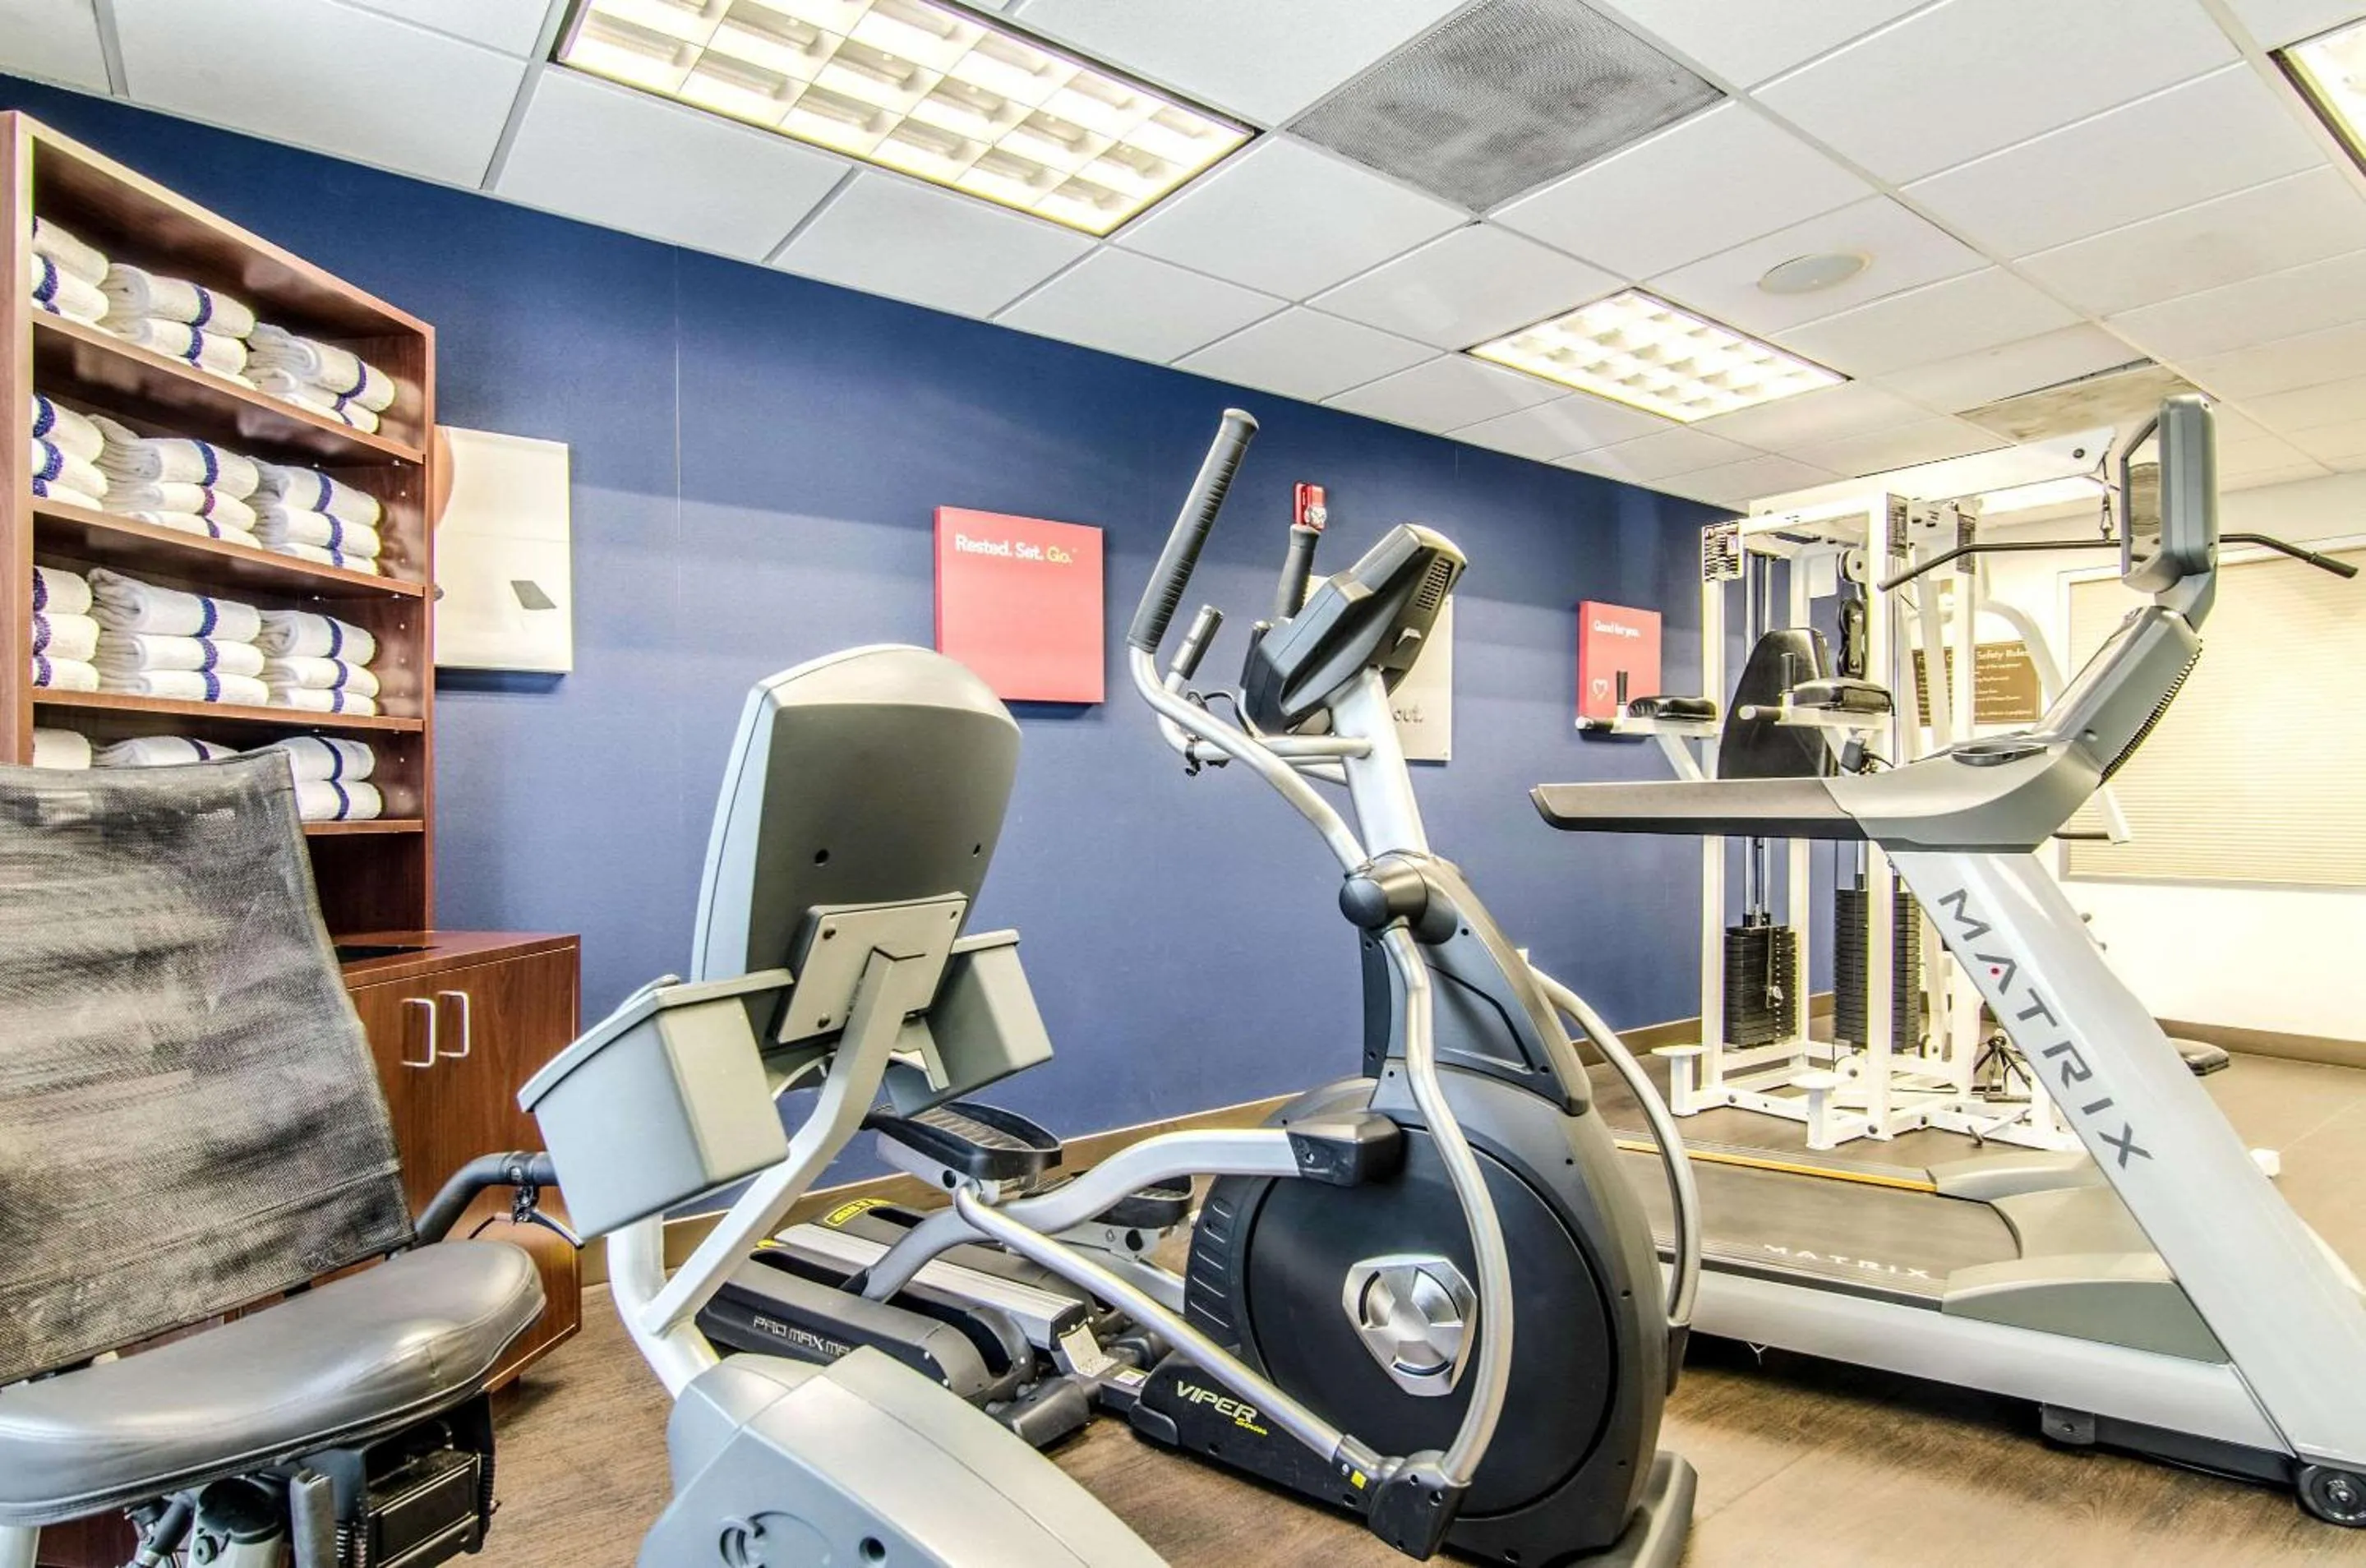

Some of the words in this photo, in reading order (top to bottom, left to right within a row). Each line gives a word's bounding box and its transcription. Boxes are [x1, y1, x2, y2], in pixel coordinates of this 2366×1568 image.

[955, 533, 1012, 556] Rested.
[1015, 542, 1045, 560] Set.
[1937, 888, 2155, 1169] MATRIX
[1764, 1244, 1930, 1280] MATRIX
[1177, 1380, 1257, 1423] VIPER
